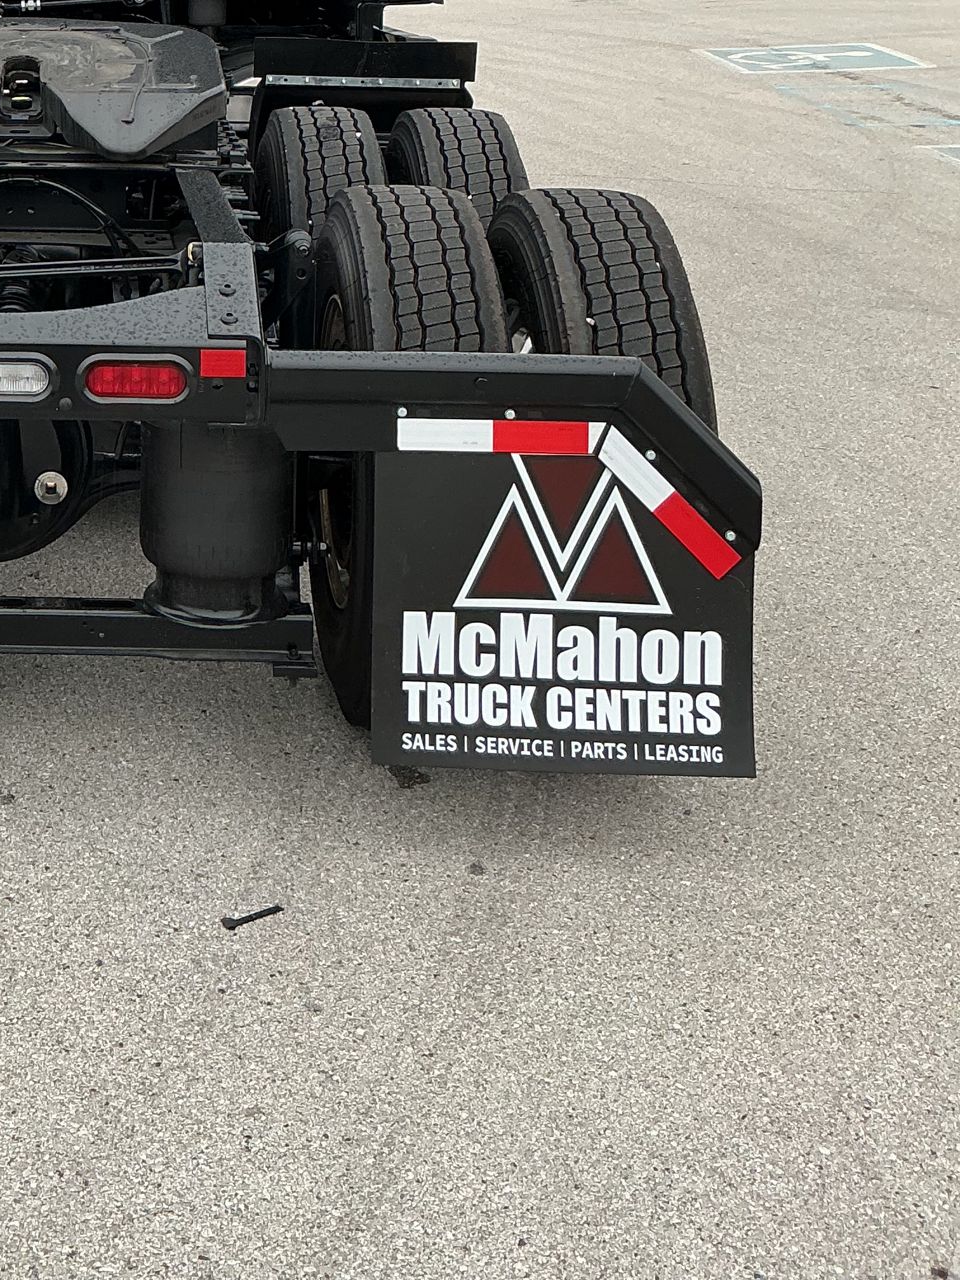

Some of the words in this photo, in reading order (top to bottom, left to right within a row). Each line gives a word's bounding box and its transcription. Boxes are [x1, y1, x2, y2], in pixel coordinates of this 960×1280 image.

[401, 610, 723, 686] McMahon
[401, 680, 538, 729] TRUCK
[545, 686, 722, 736] CENTERS
[401, 732, 458, 752] SALES
[474, 736, 554, 757] SERVICE
[570, 740, 628, 760] PARTS
[644, 743, 724, 764] LEASING
